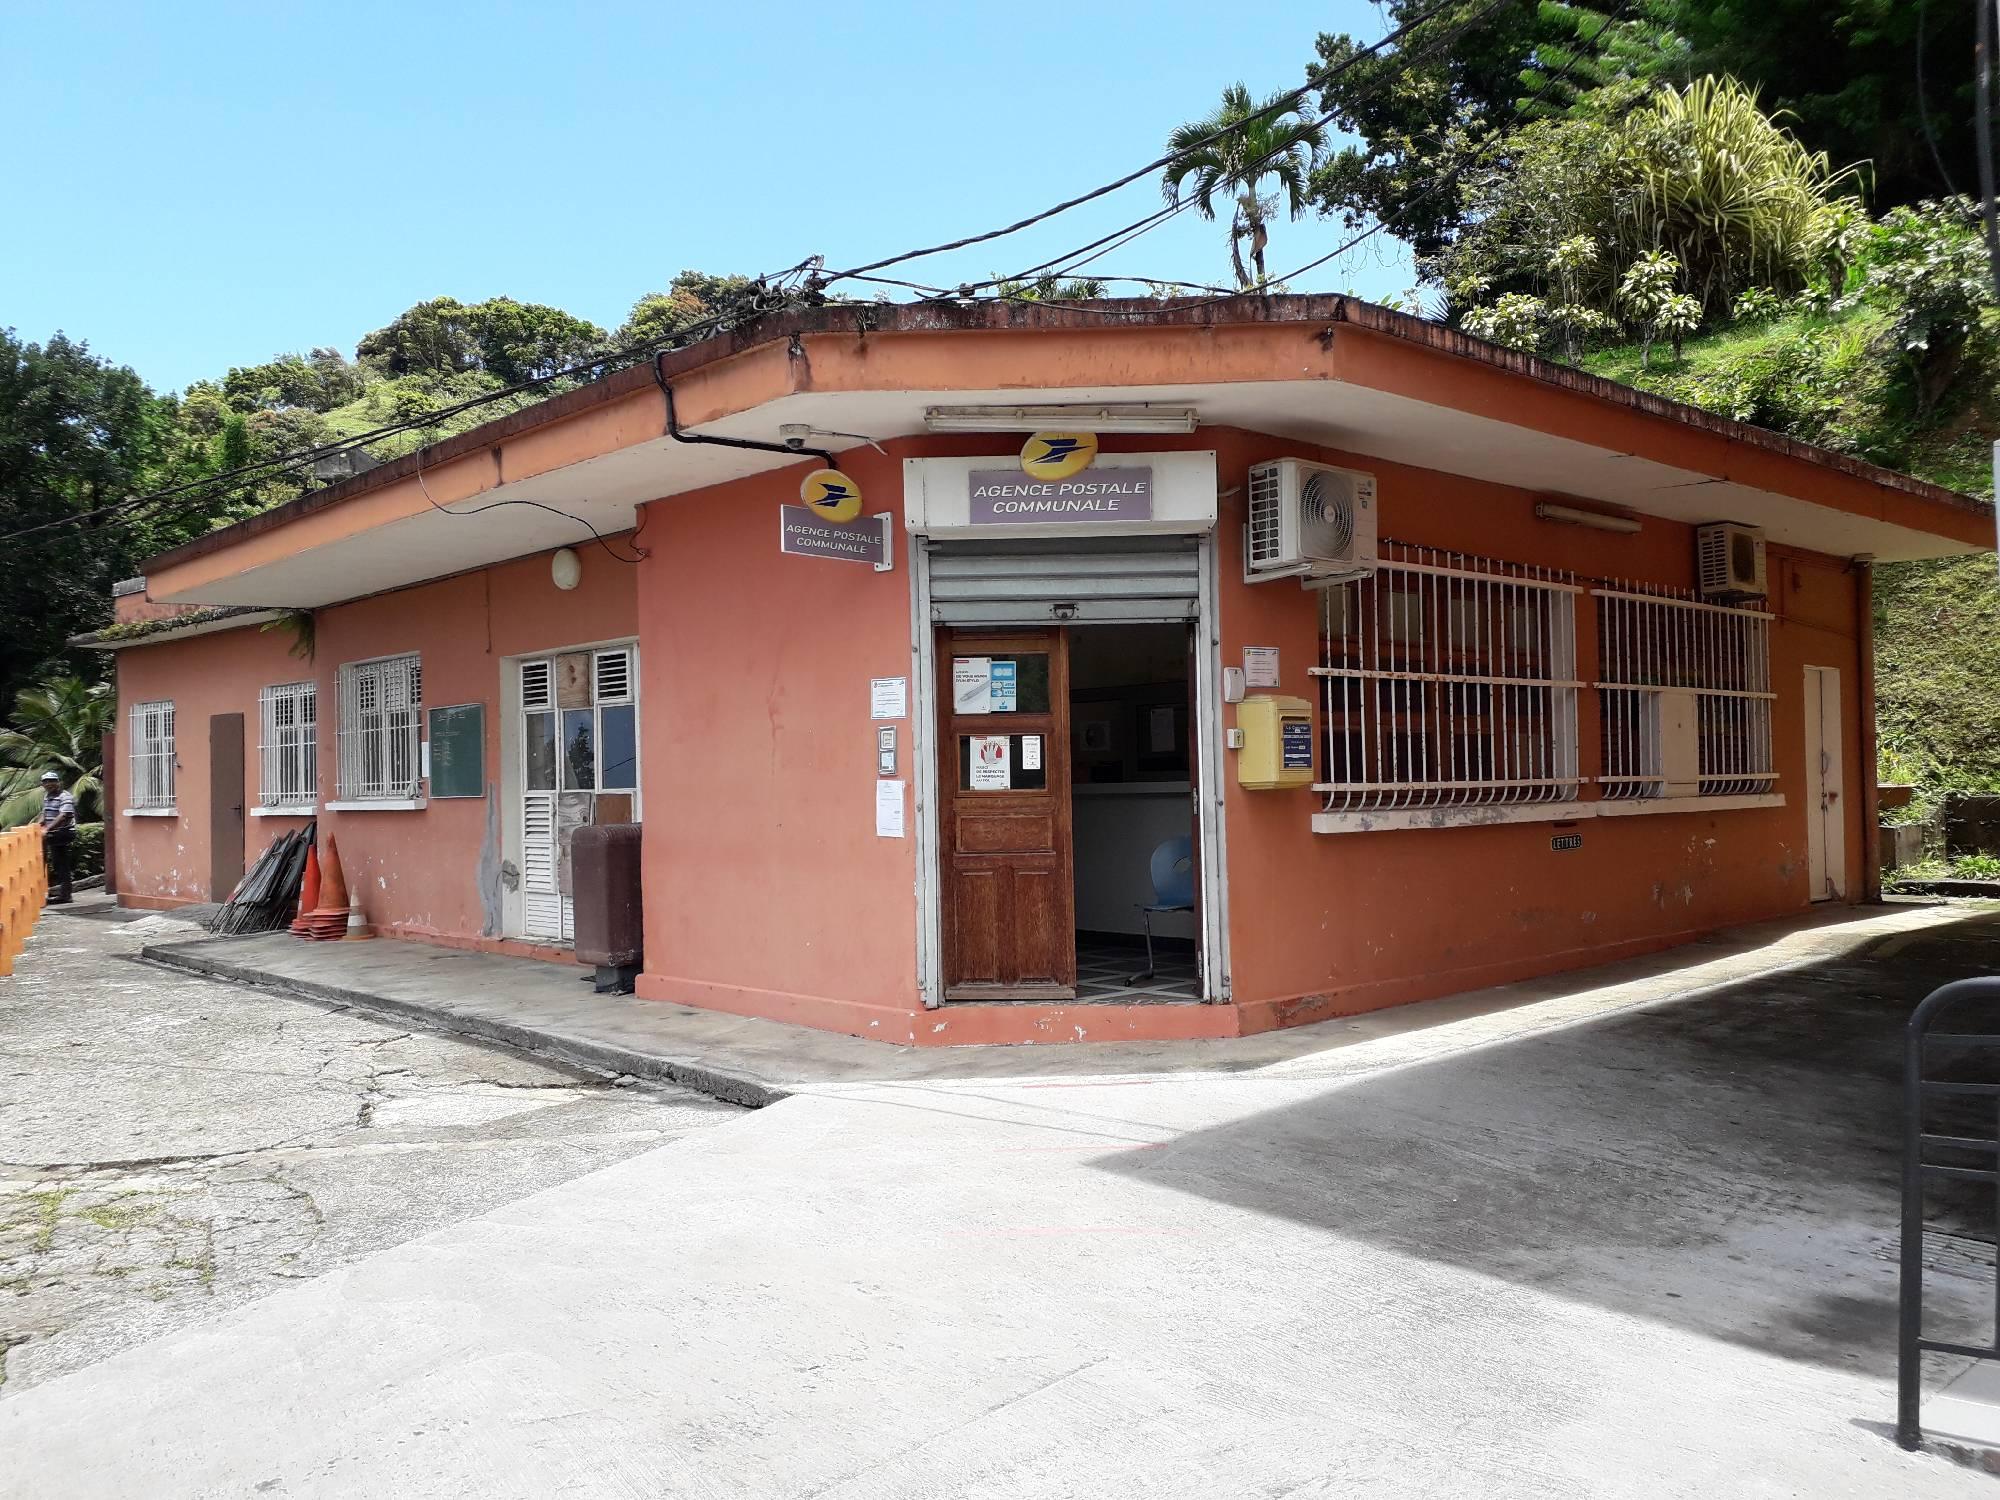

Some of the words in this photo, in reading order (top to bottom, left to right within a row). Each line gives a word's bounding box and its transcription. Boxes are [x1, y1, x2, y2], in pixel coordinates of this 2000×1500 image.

[974, 484, 1054, 498] AGENCE
[1059, 482, 1147, 495] POSTALE
[993, 499, 1121, 514] COMMUNALE
[786, 524, 830, 538] AGENCE
[833, 530, 881, 545] POSTALE
[796, 537, 867, 554] COMMUNALE
[1553, 836, 1581, 848] LETTRES
